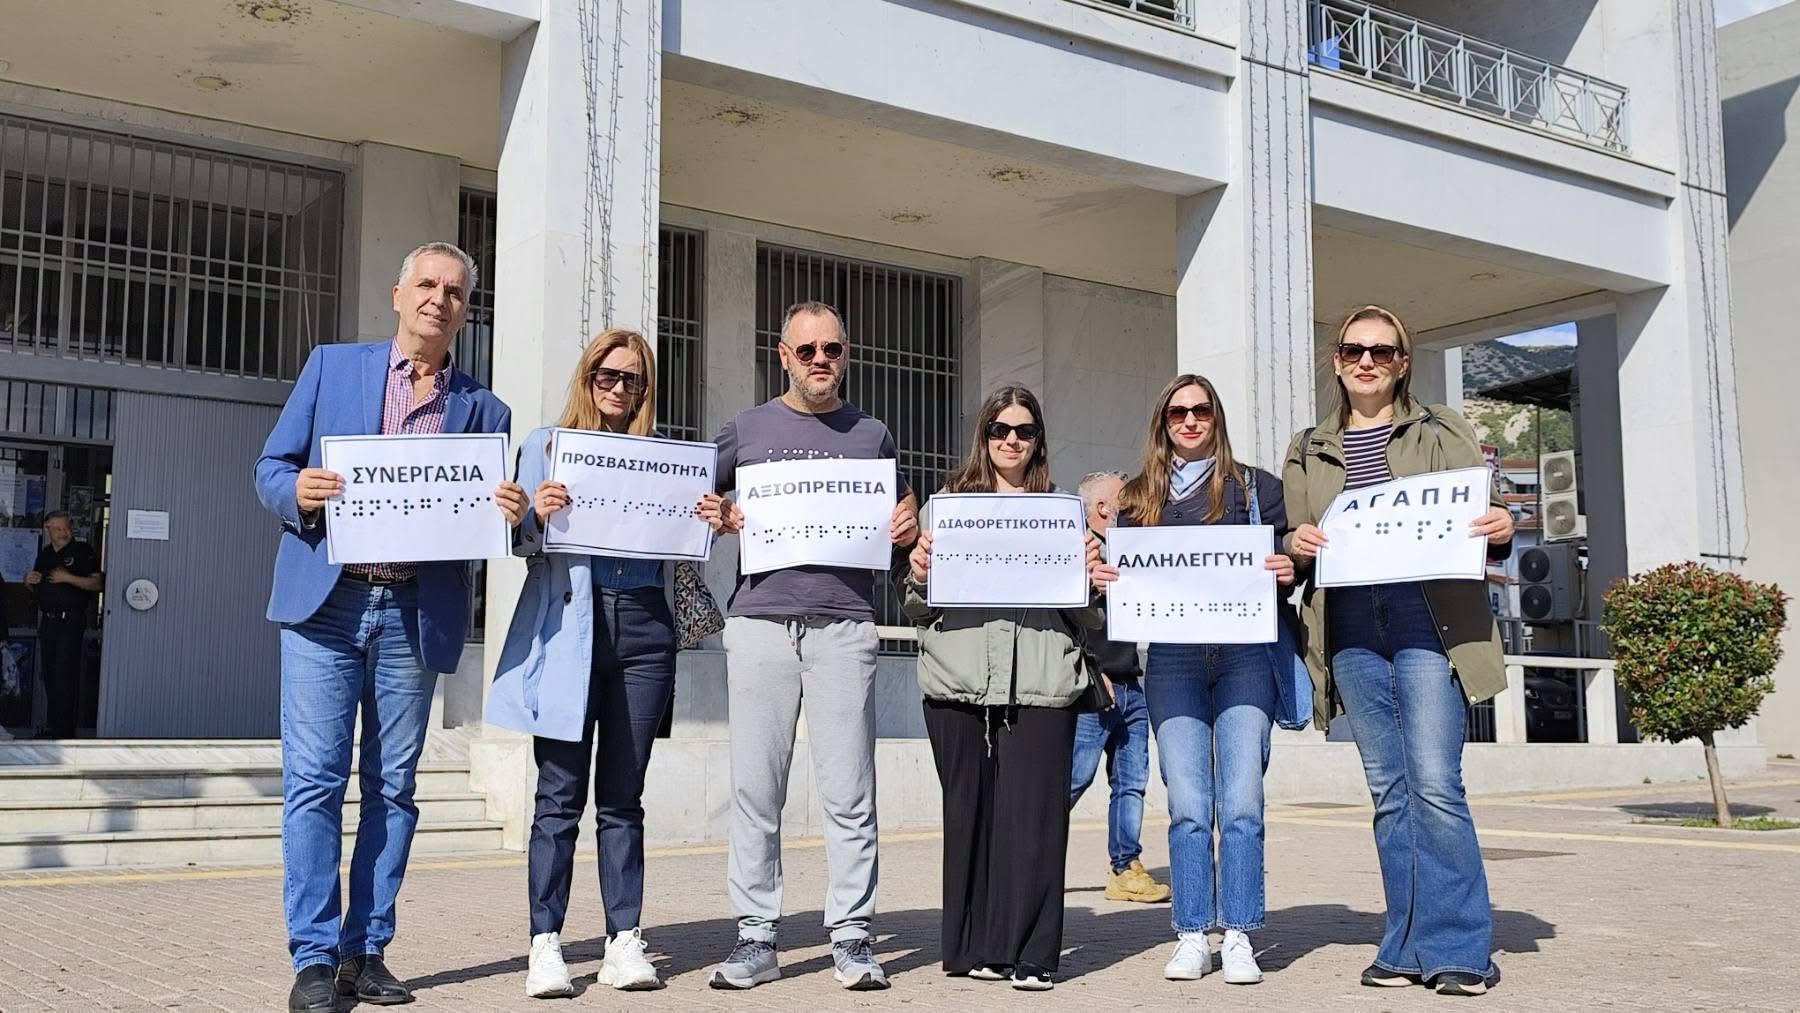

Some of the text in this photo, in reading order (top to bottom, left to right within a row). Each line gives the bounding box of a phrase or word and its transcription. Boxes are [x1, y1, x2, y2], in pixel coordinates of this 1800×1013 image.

[352, 464, 485, 485] ΣΥΝΕΡΓΑΣΙΑ
[562, 451, 709, 479] ΠΡΟΣΒΑΣΙΜΟΤΗΤΑ
[747, 480, 887, 500] ΑΞΙΟΠΡΕΠΕΙΑ
[1342, 485, 1471, 513] ΑΓΑΠΗ
[938, 518, 1077, 529] ΔΙΑΦΟΡΕΤΙΚΟΤΗΤΑ
[1117, 552, 1253, 569] ΑΛΛΗΛΕΓΓΥΗ
